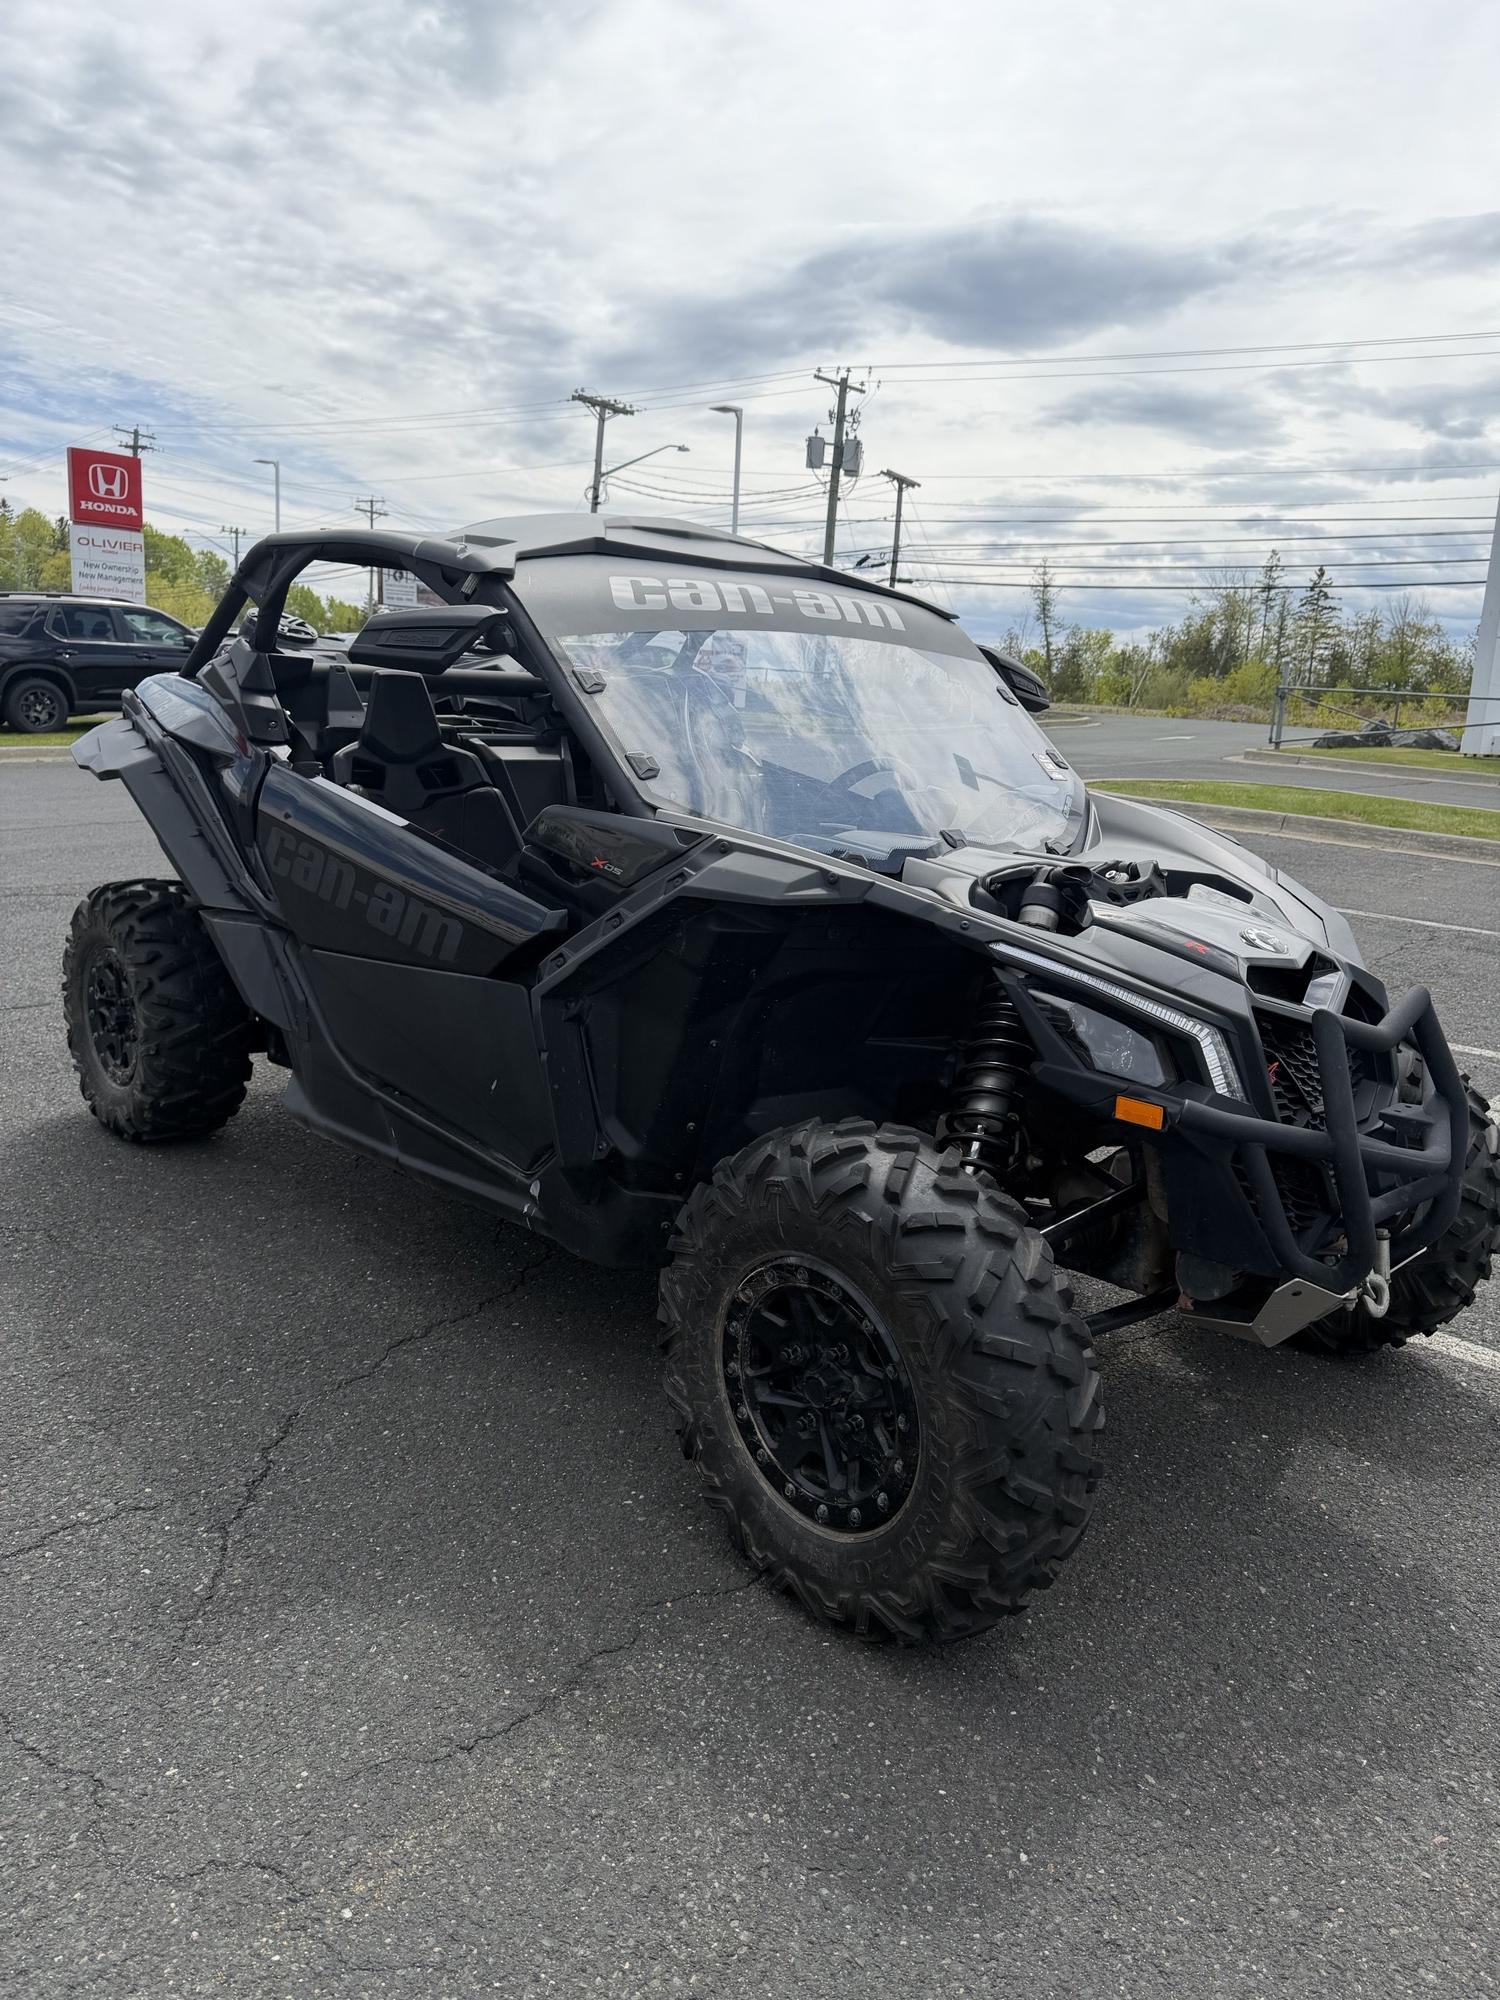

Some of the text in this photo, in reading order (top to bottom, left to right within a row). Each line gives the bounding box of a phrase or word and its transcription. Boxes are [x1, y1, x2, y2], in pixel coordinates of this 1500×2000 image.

[80, 500, 138, 516] HONDA
[77, 537, 143, 553] OLIVIER
[83, 561, 139, 575] New Ownership
[79, 571, 143, 584] New Management
[608, 575, 906, 631] can-am
[265, 826, 464, 961] can-am
